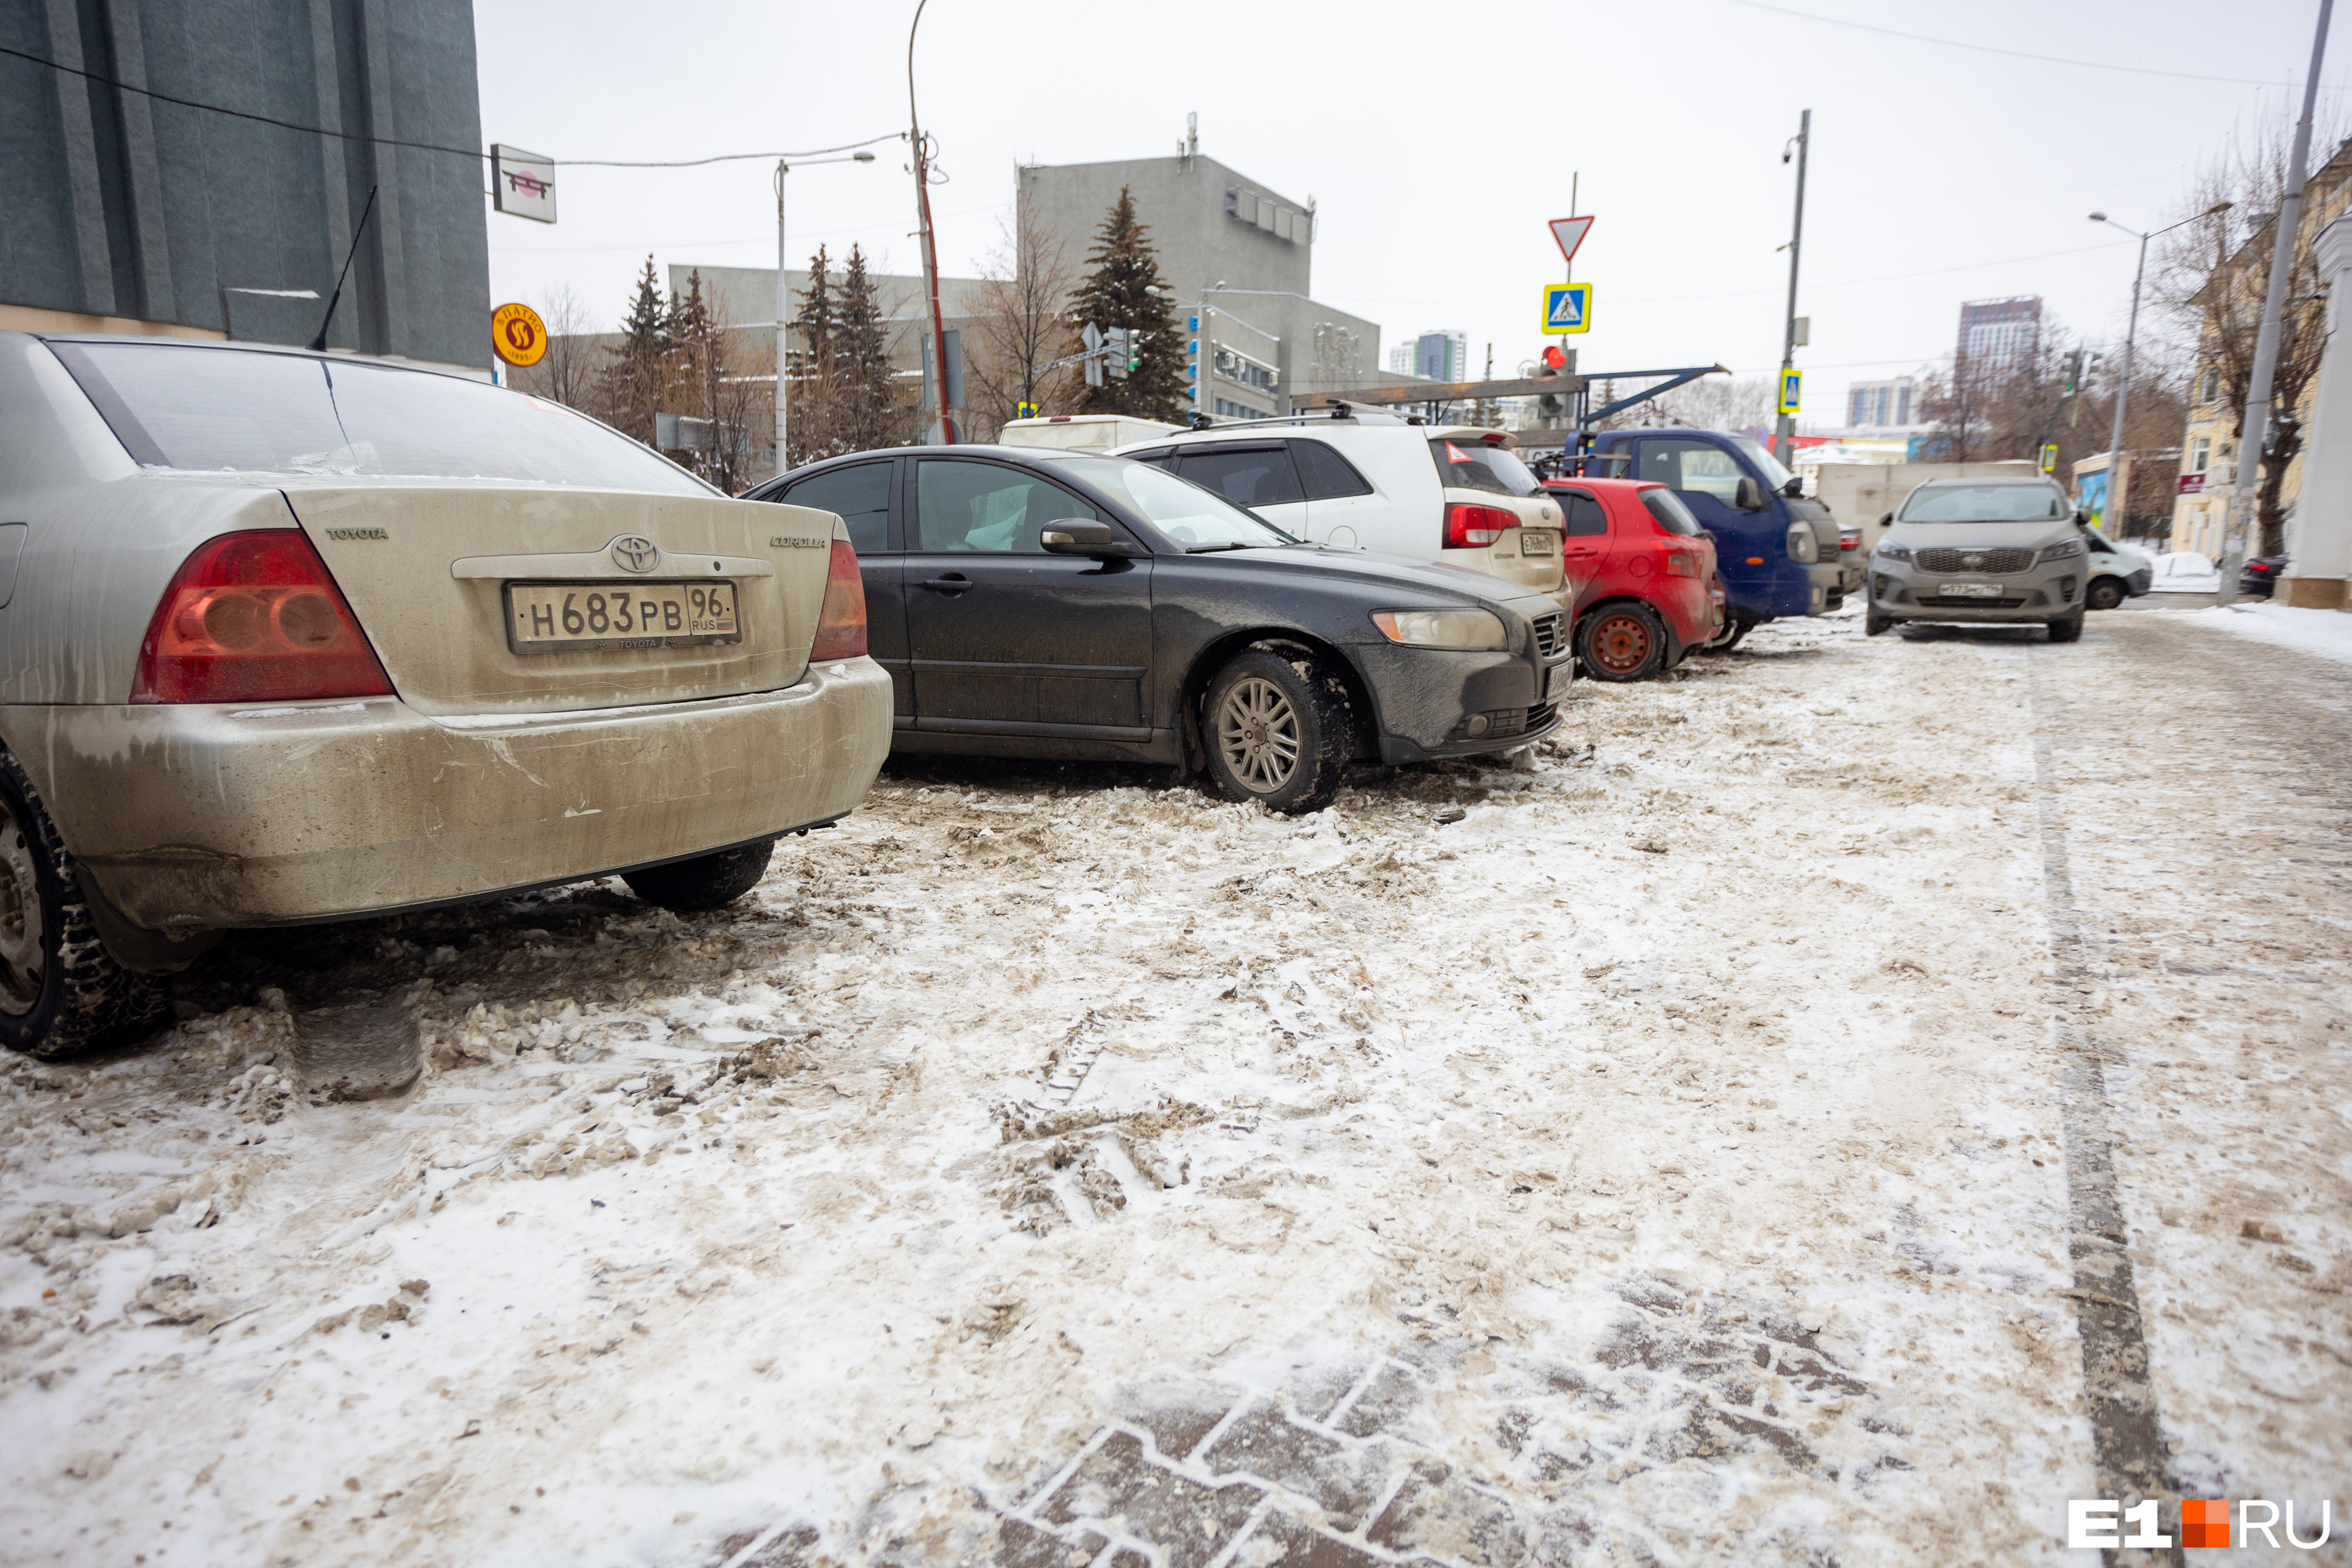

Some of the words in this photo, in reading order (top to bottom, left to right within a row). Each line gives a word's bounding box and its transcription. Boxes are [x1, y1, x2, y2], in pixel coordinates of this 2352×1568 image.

[503, 306, 542, 333] ПАТИО
[325, 527, 389, 540] TOYOTA
[770, 535, 826, 549] COROLLA
[531, 592, 682, 636] Н683РВ
[691, 588, 724, 618] 96
[691, 619, 716, 631] RUS
[619, 638, 657, 649] TOYOTA
